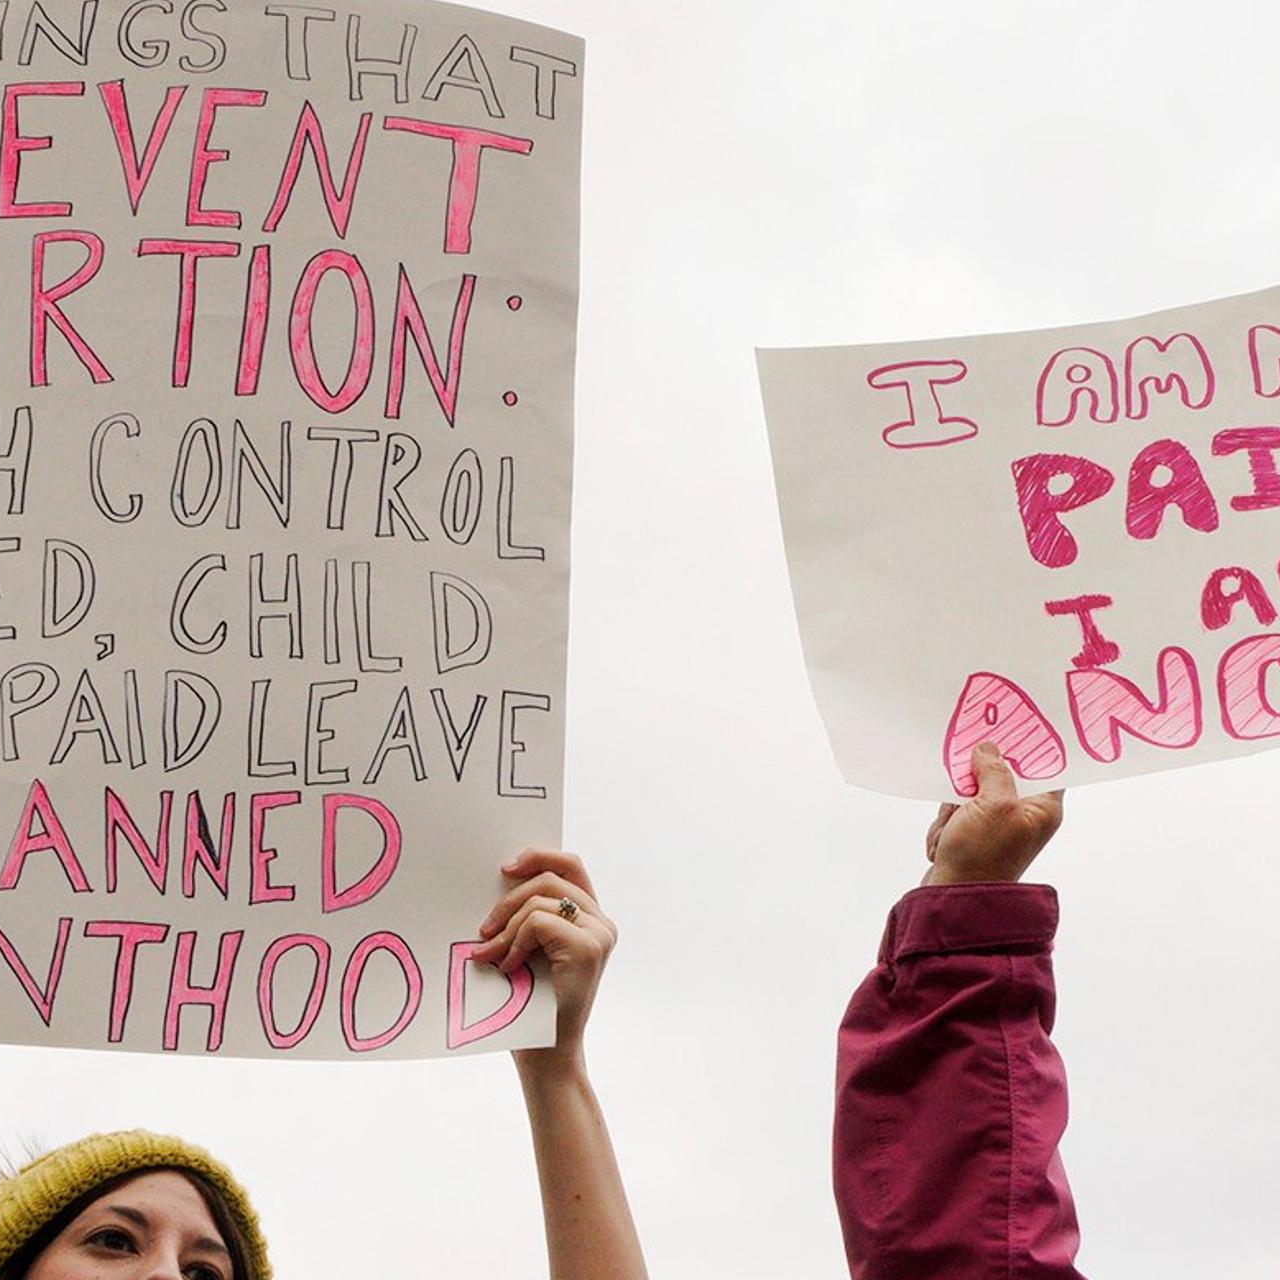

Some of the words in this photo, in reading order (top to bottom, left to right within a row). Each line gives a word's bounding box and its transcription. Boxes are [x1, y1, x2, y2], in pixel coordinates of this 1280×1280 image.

[264, 3, 577, 121] THAT
[867, 357, 979, 449] I
[1036, 332, 1216, 428] AM
[87, 406, 546, 562] CONTROL
[168, 552, 494, 677] CHILD
[1043, 593, 1121, 670] I
[246, 678, 553, 799] LEAVE
